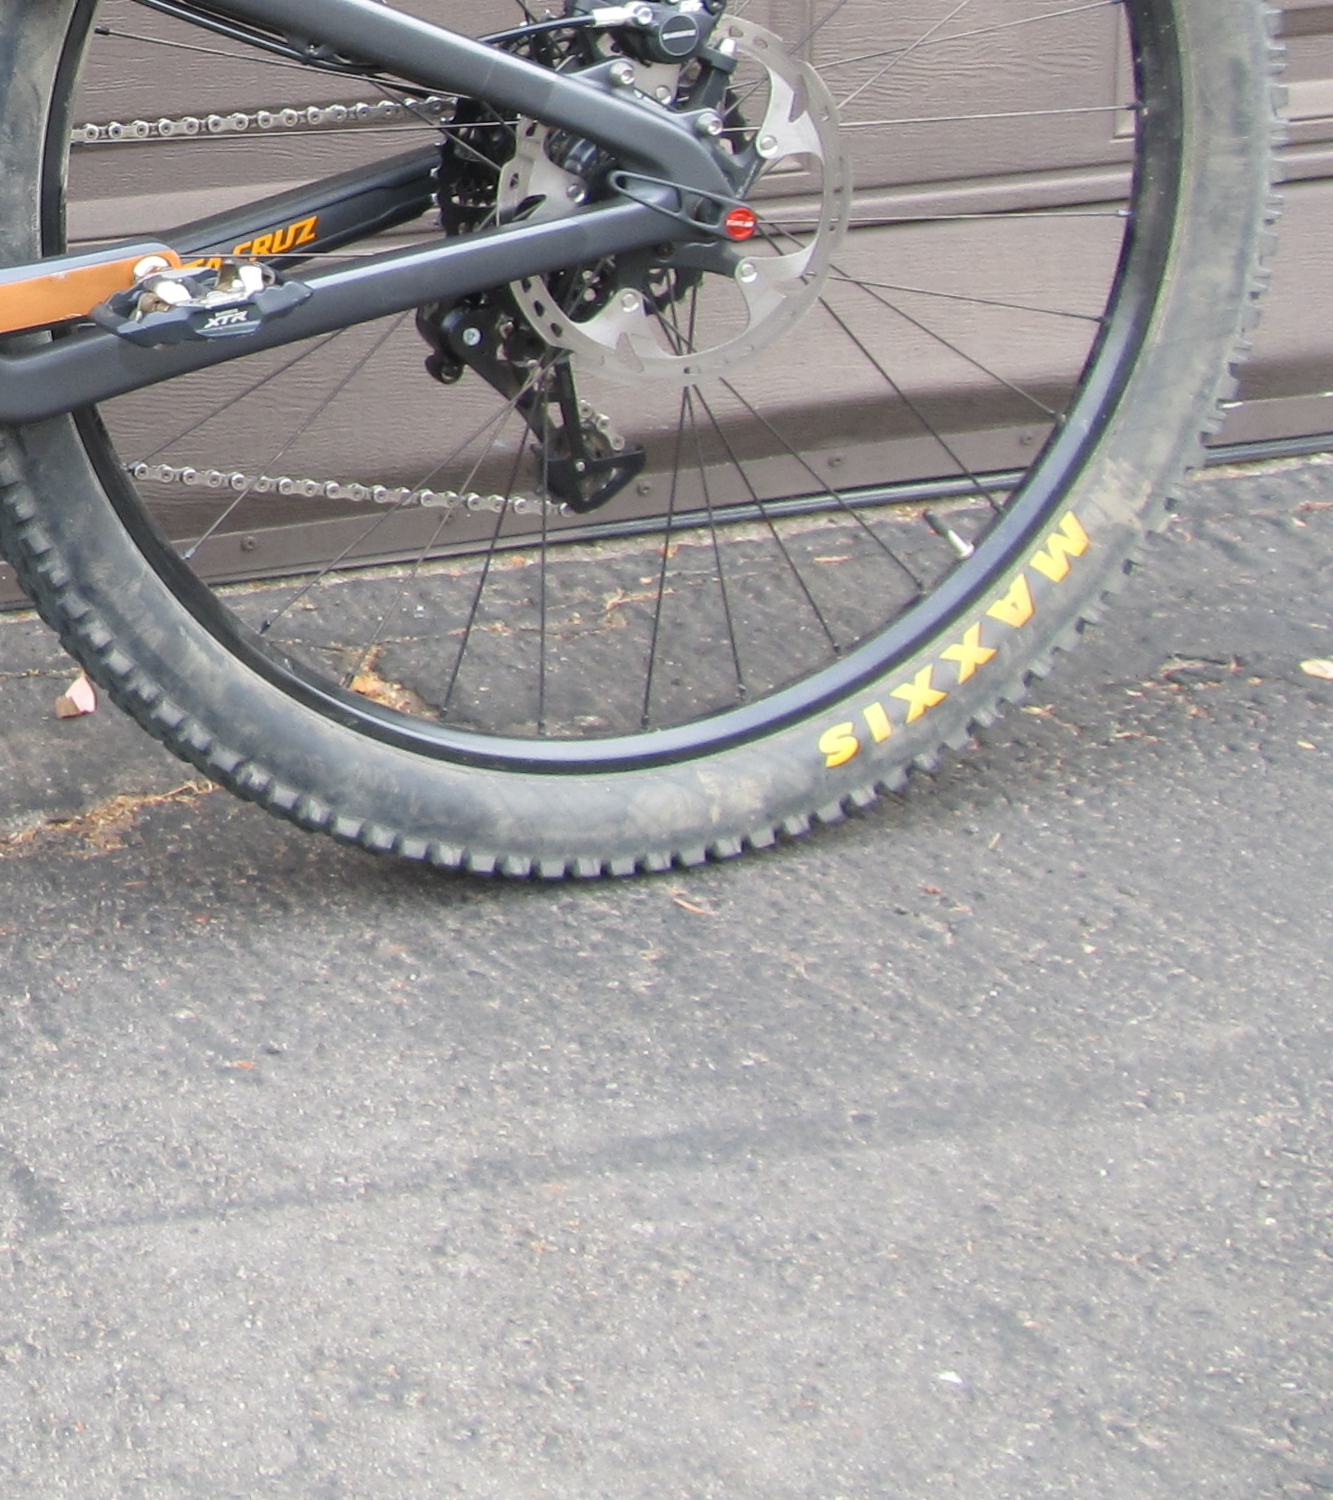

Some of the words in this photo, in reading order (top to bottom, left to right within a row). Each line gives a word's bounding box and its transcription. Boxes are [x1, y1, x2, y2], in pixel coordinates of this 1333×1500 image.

[232, 214, 318, 262] CRUZ
[203, 310, 249, 328] XTR
[818, 510, 1091, 768] MAXXIS
